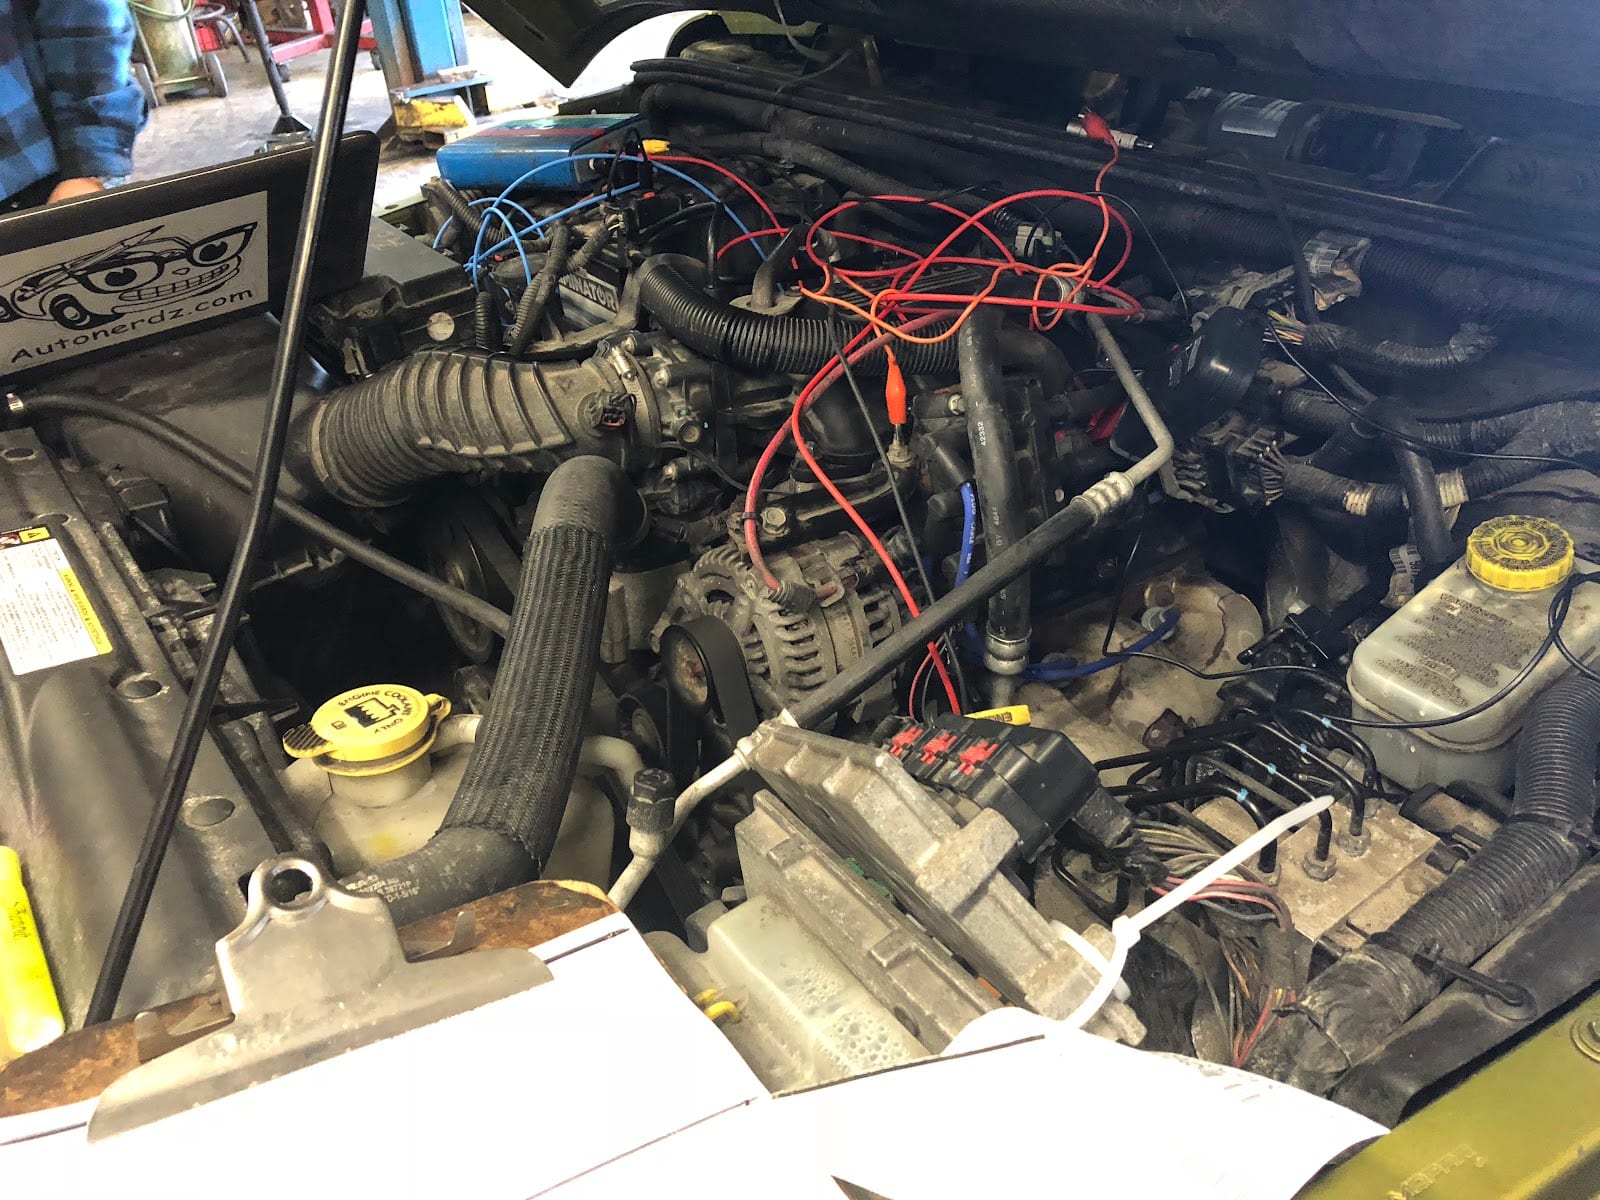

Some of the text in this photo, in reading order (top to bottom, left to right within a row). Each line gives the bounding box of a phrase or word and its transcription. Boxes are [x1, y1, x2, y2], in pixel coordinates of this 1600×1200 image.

[11, 289, 254, 364] Autonerdz.com
[977, 420, 987, 447] 42332
[338, 690, 381, 707] ENGINE
